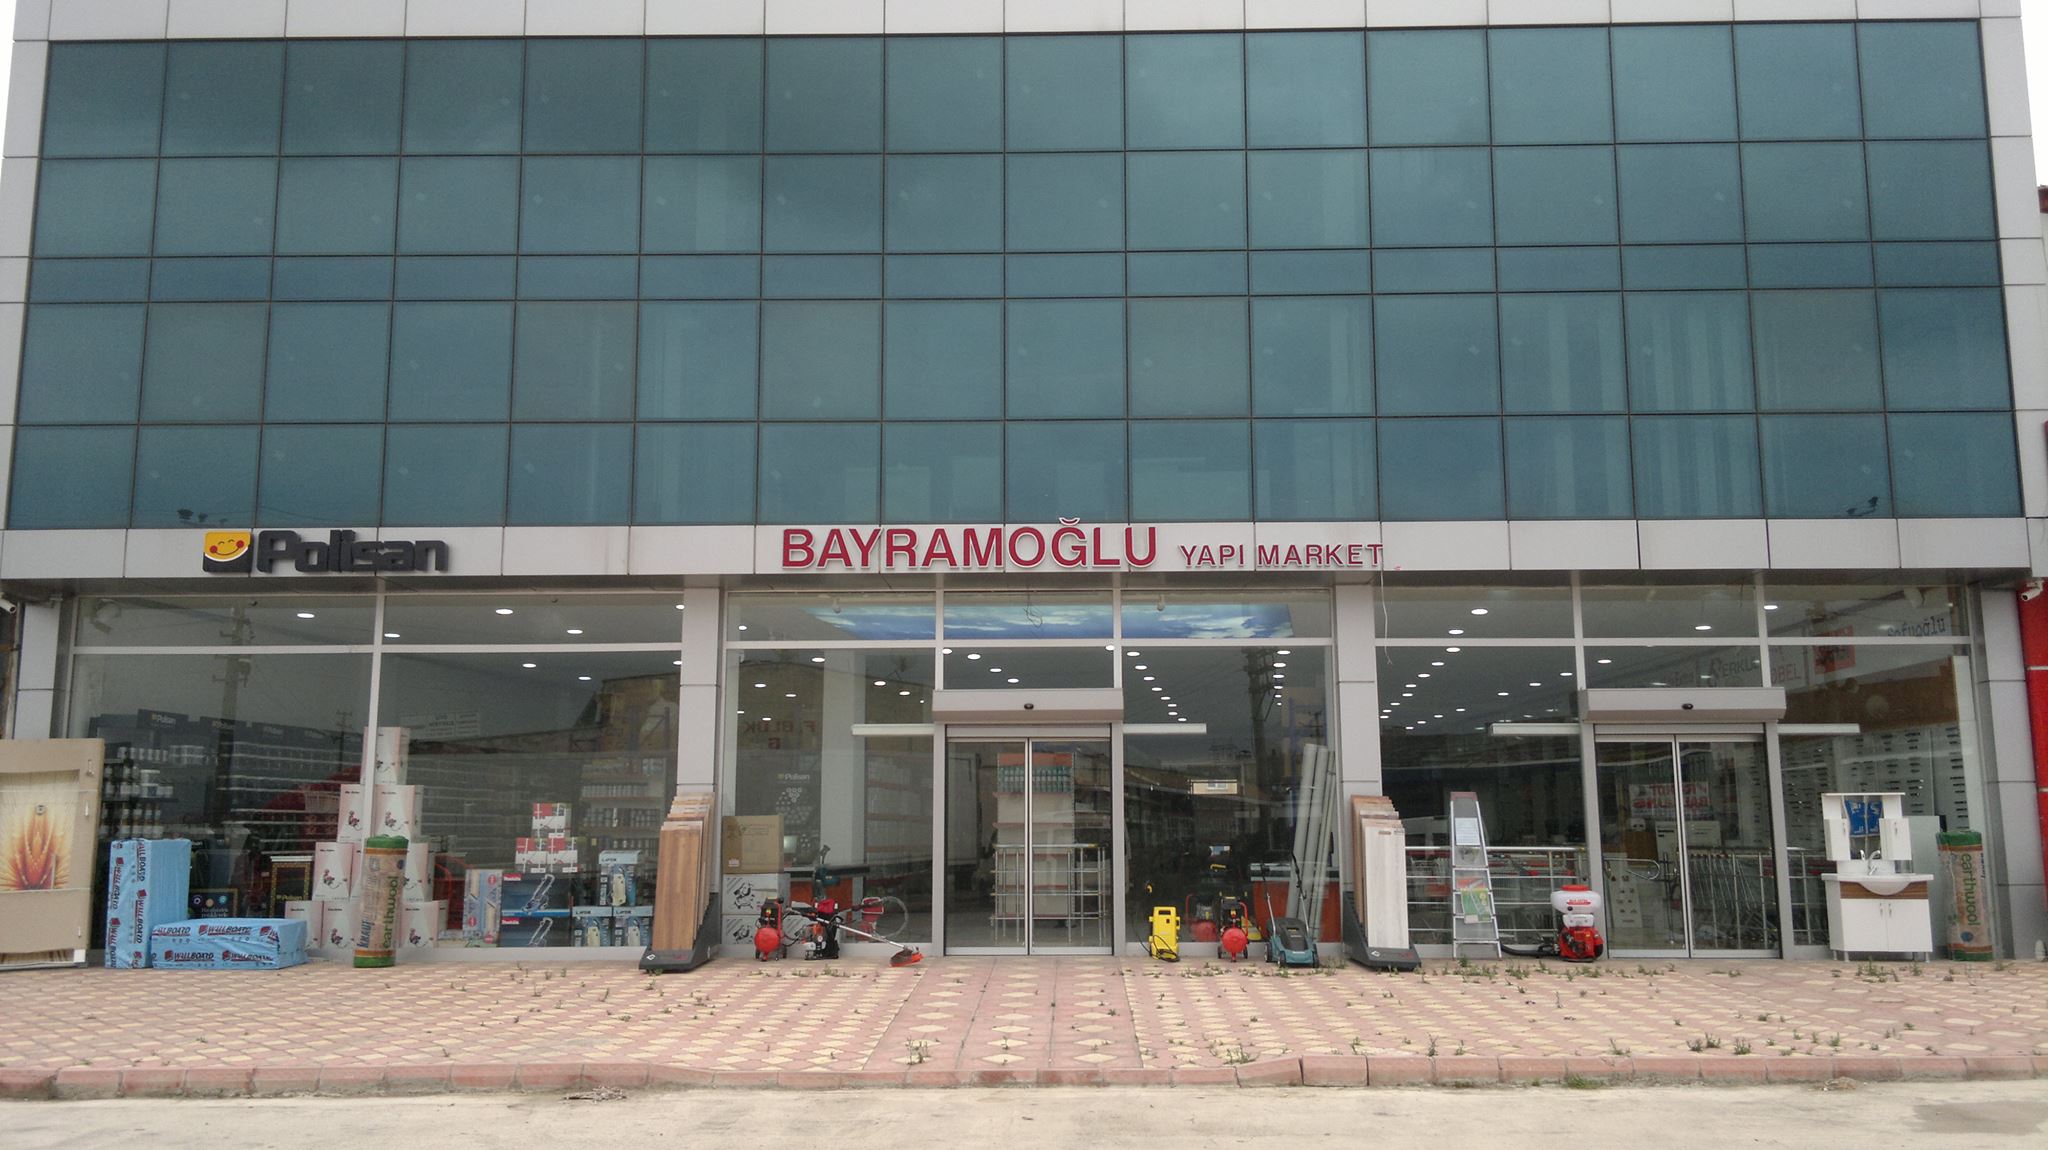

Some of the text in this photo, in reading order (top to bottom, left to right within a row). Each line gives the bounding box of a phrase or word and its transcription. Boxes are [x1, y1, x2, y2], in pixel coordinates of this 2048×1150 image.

[256, 529, 450, 574] Polisan
[781, 516, 1385, 570] BAYRAMOĞLU YAPI MARKET
[383, 876, 399, 949] earthwool
[1961, 853, 1980, 926] earthwool
